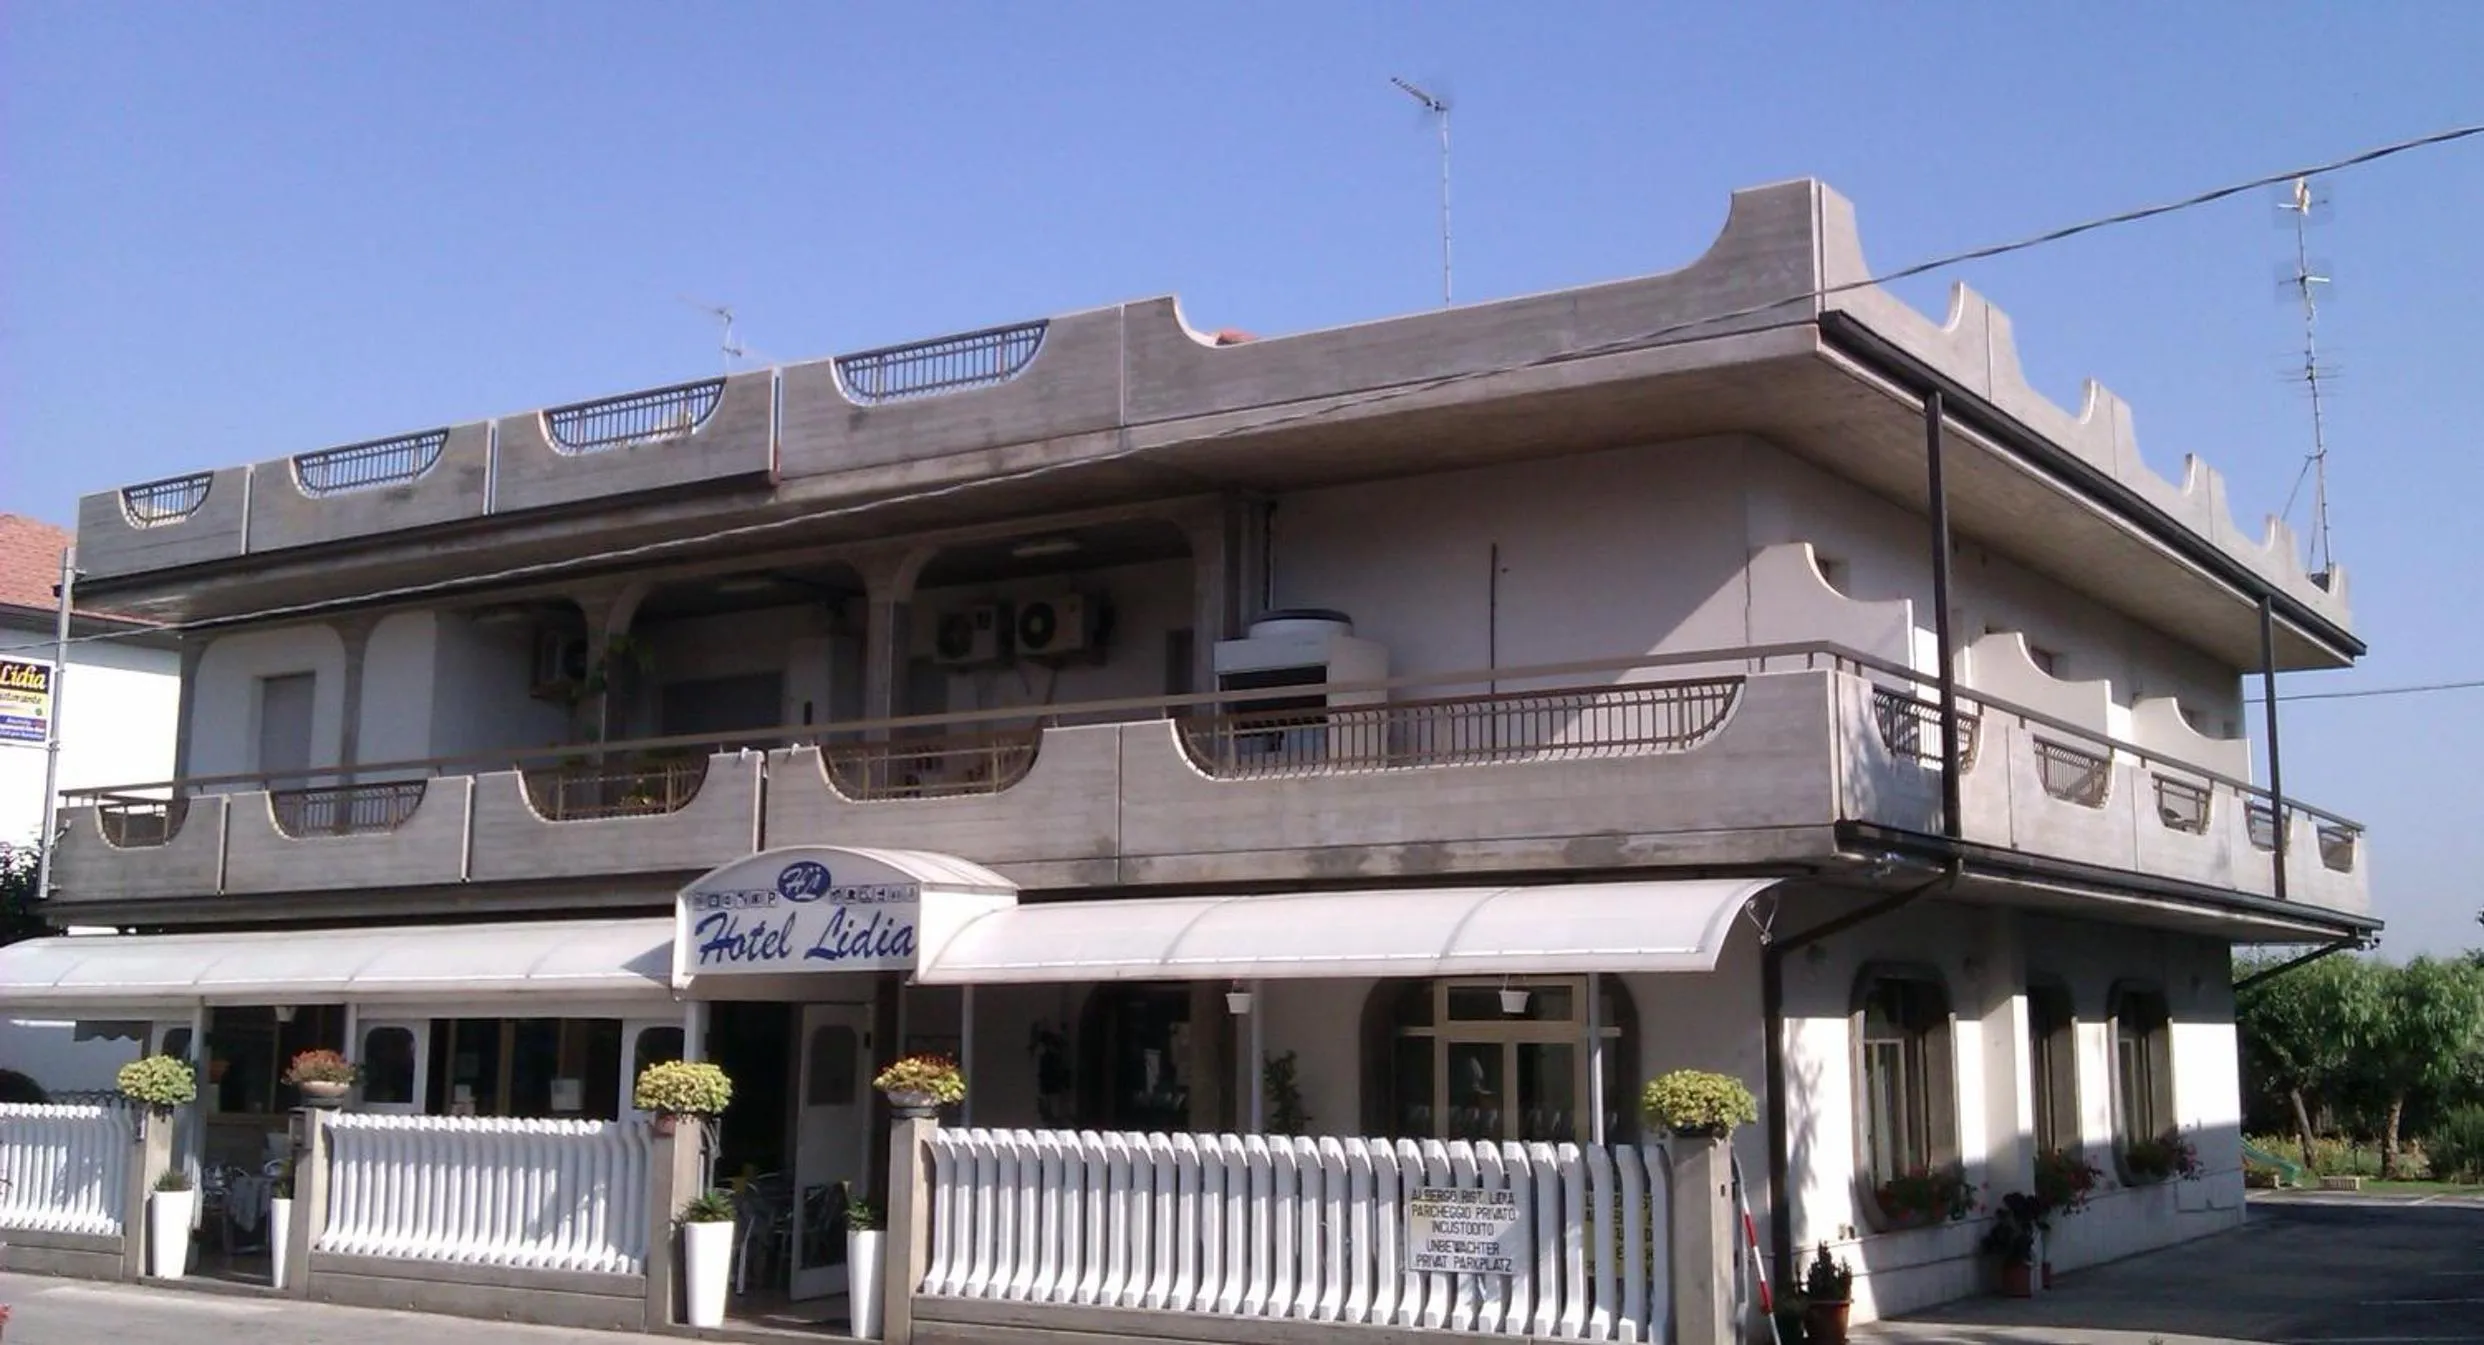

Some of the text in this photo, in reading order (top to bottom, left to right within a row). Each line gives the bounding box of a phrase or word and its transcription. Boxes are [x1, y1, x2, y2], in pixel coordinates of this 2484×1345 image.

[695, 906, 916, 965] Hotel Lidia
[1411, 1204, 1516, 1221] PARCHEGGIO PRIVATO
[1427, 1239, 1500, 1256] UNBEWACHTER
[1416, 1254, 1512, 1272] PRIVAT PARKPLATZ
